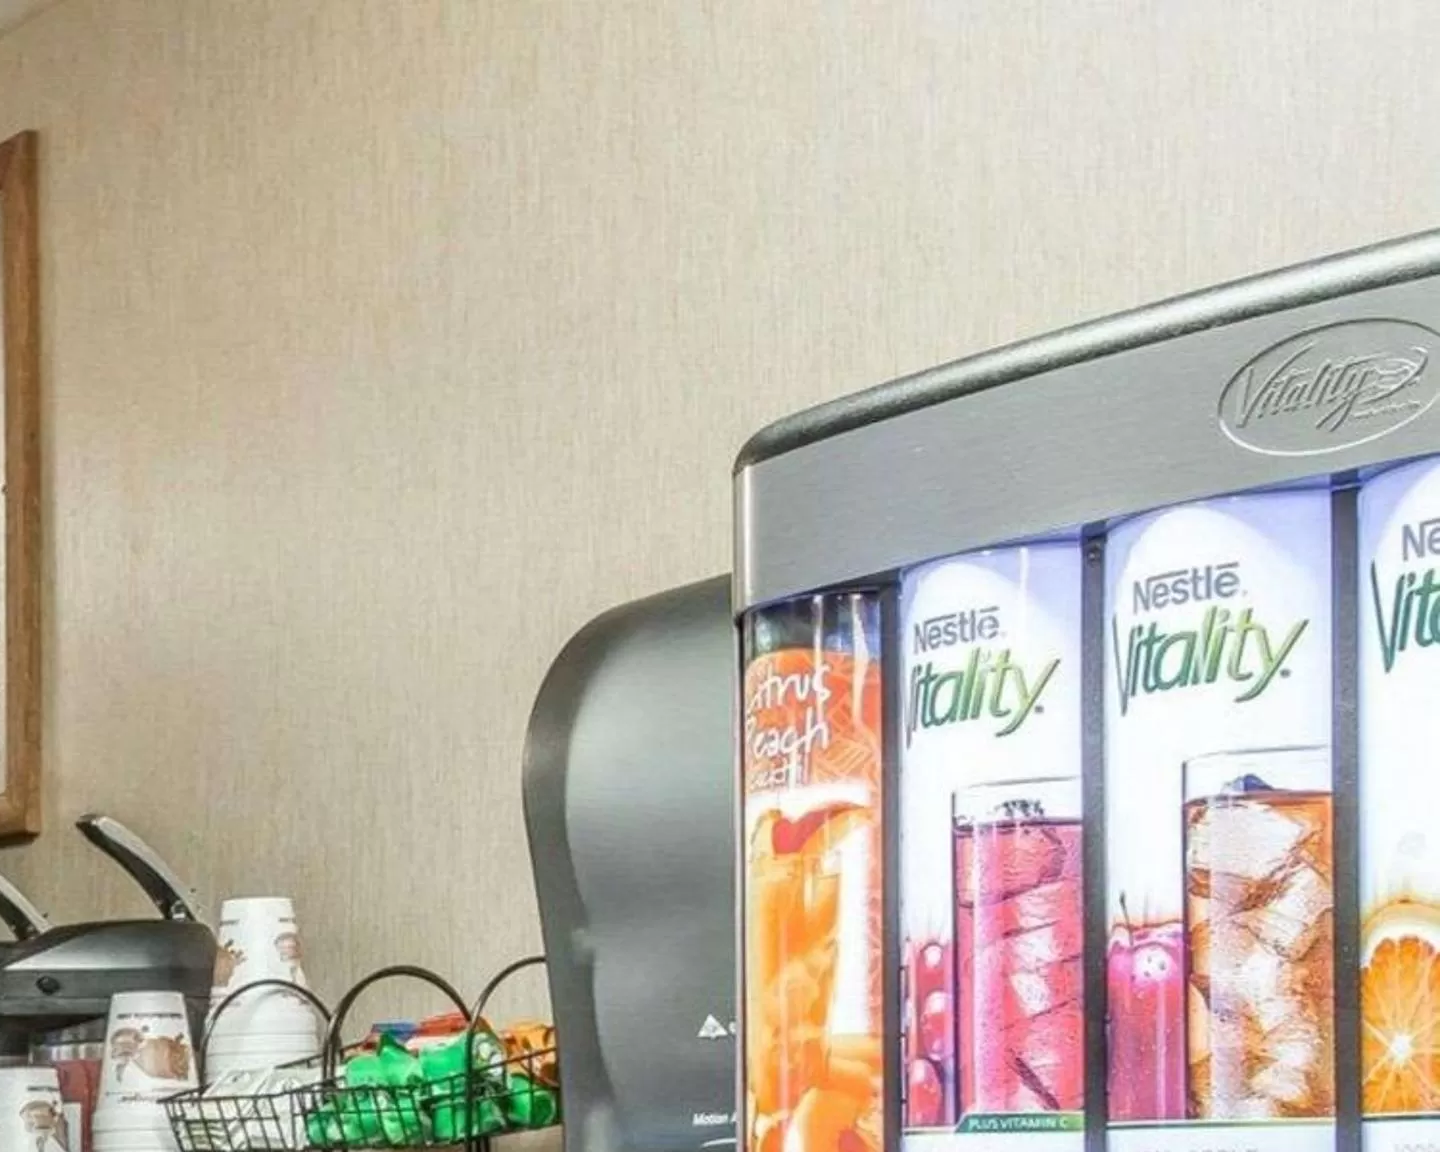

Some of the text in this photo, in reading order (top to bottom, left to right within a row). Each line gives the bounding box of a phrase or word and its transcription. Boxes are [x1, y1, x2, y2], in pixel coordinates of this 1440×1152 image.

[1112, 606, 1310, 717] Vitality
[1000, 1116, 1057, 1130] VITAMIN
[1060, 1116, 1068, 1129] C
